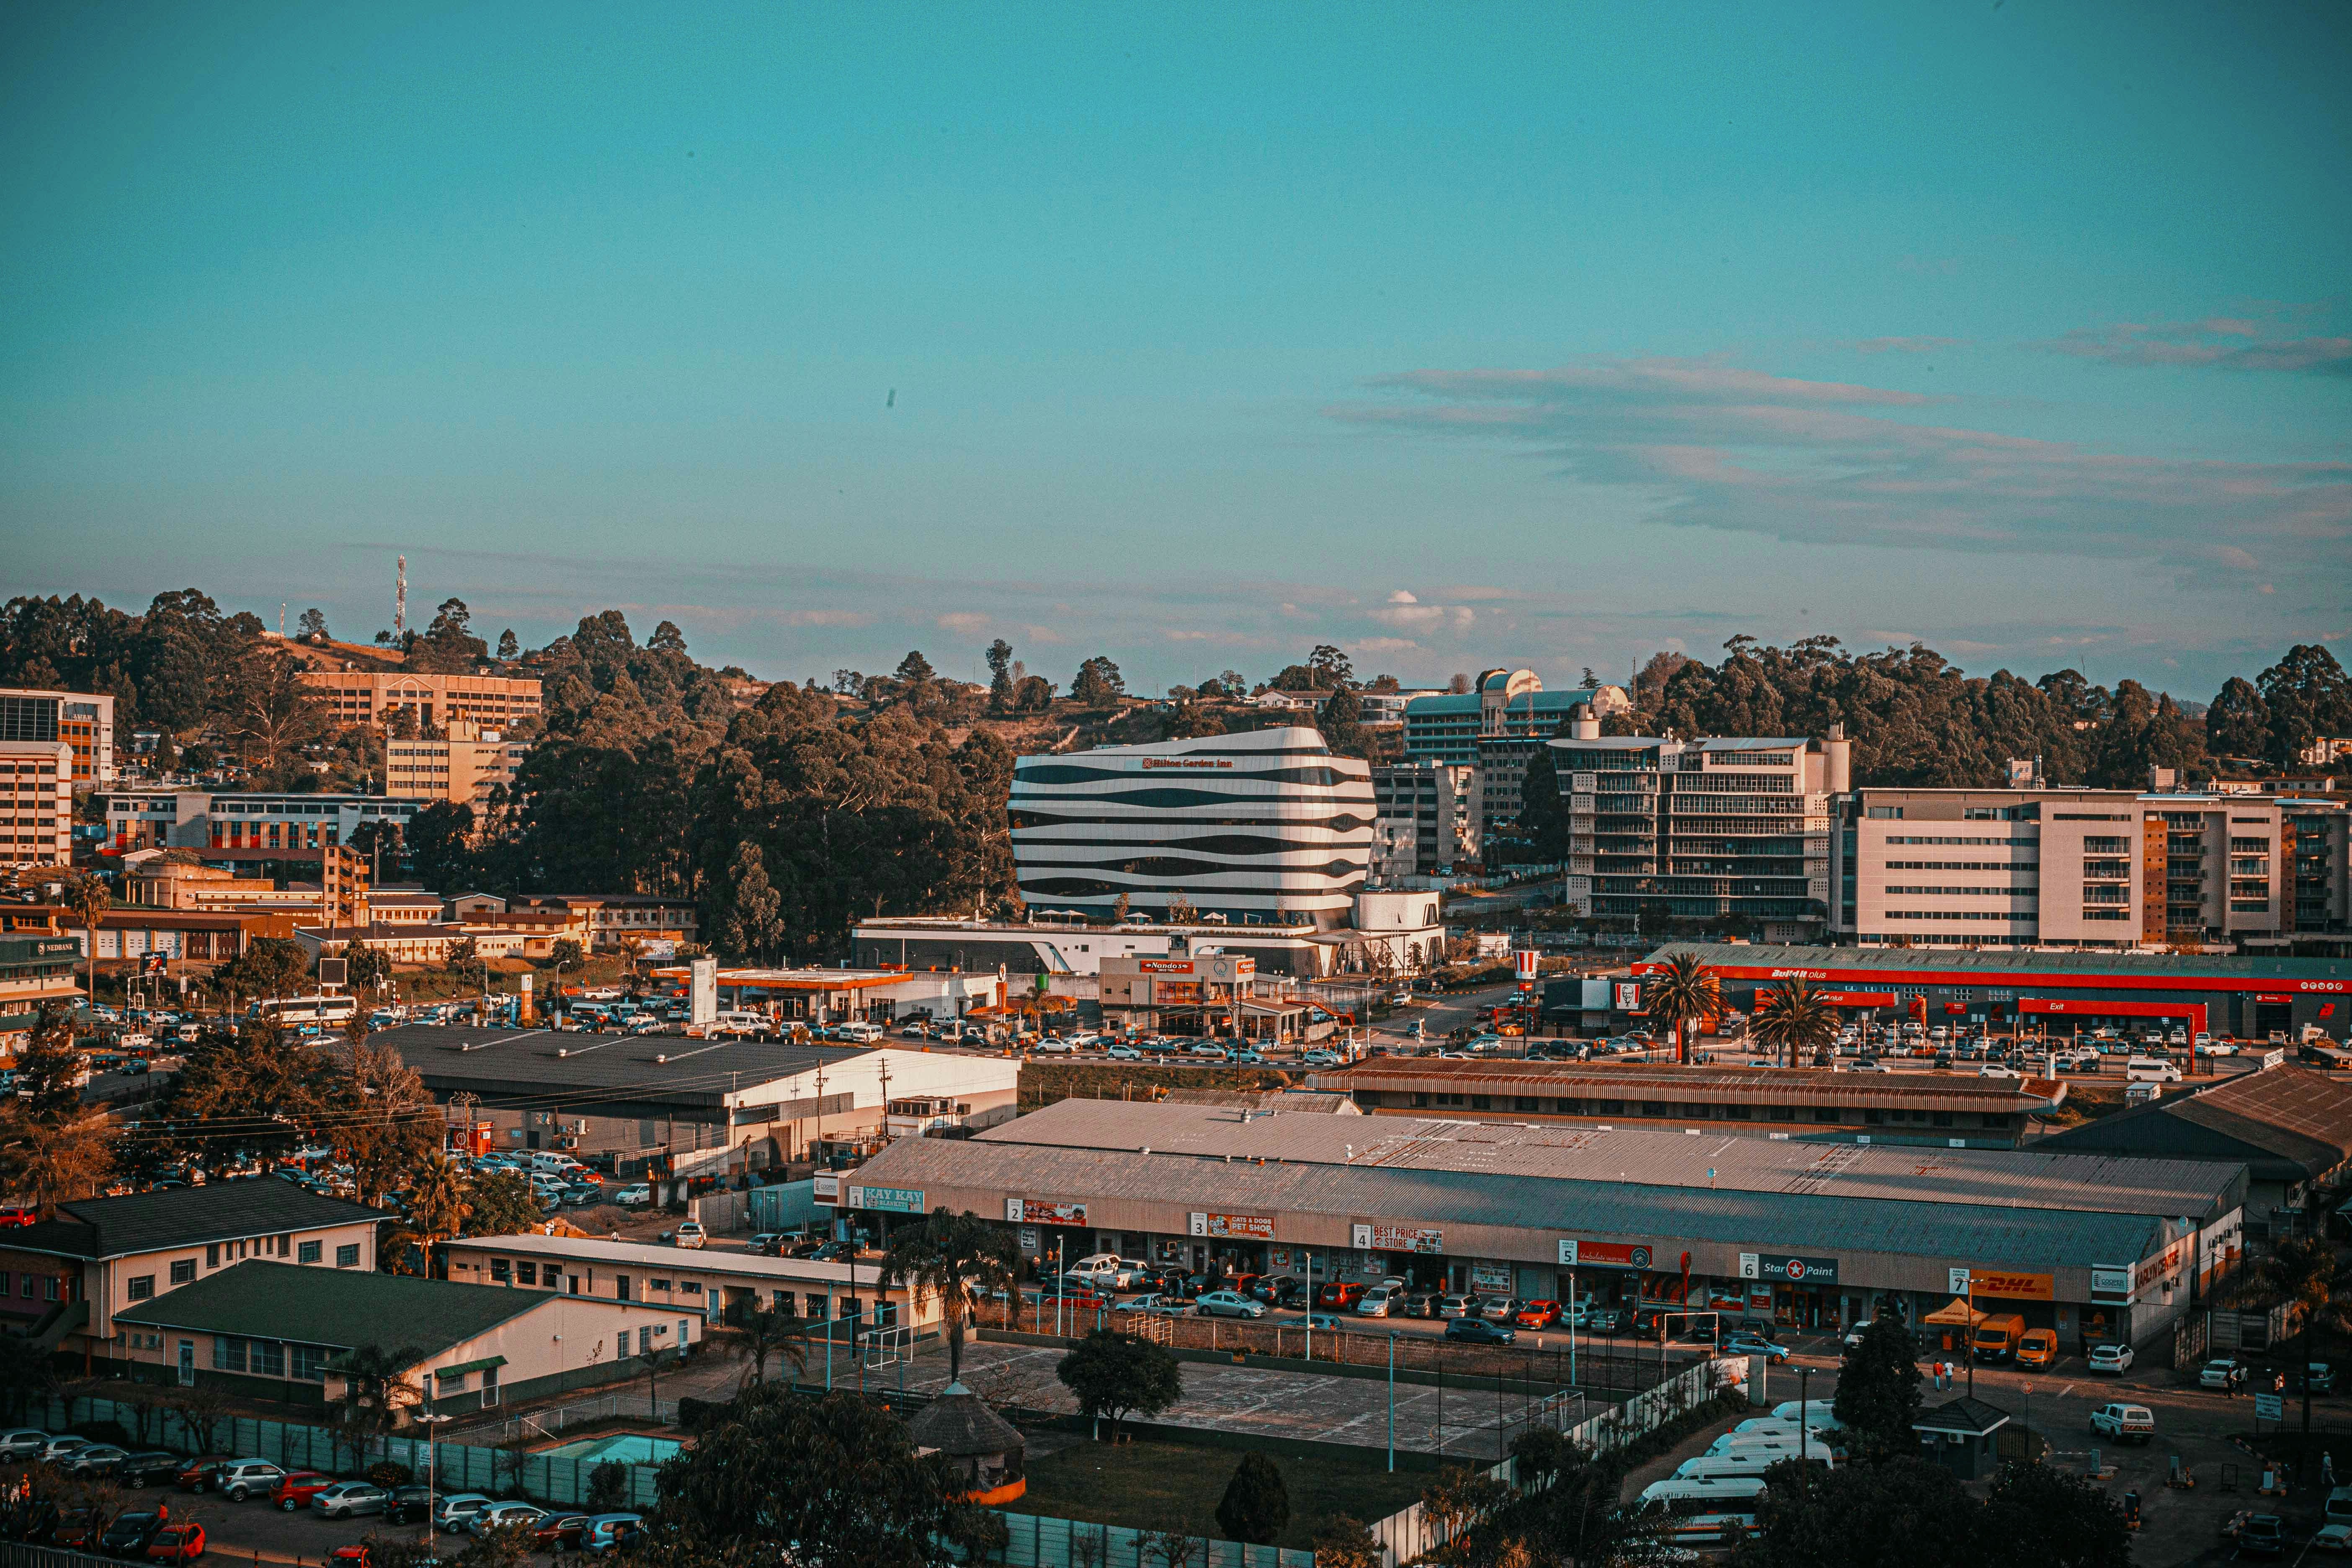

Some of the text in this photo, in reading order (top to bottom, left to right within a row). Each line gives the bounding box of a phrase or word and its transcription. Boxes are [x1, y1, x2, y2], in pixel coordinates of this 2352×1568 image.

[1153, 758, 1233, 768] Hilton Garden Inn
[854, 1195, 859, 1206] 1
[866, 1189, 922, 1202] KAY KAY
[1012, 1208, 1018, 1219] 2
[1196, 1222, 1202, 1234] 3
[1249, 1224, 1271, 1233] SHOP
[1374, 1226, 1418, 1239] BEST PRICE
[1359, 1235, 1366, 1246] 4
[1385, 1237, 1408, 1248] STORE
[1564, 1251, 1572, 1262] 5
[1745, 1264, 1753, 1276] 6
[1764, 1263, 1834, 1276] Star Paint
[2136, 1248, 2179, 1289] KARLYN CENTRE
[1955, 1278, 1963, 1291] 7
[1987, 1277, 2037, 1293] DHL
